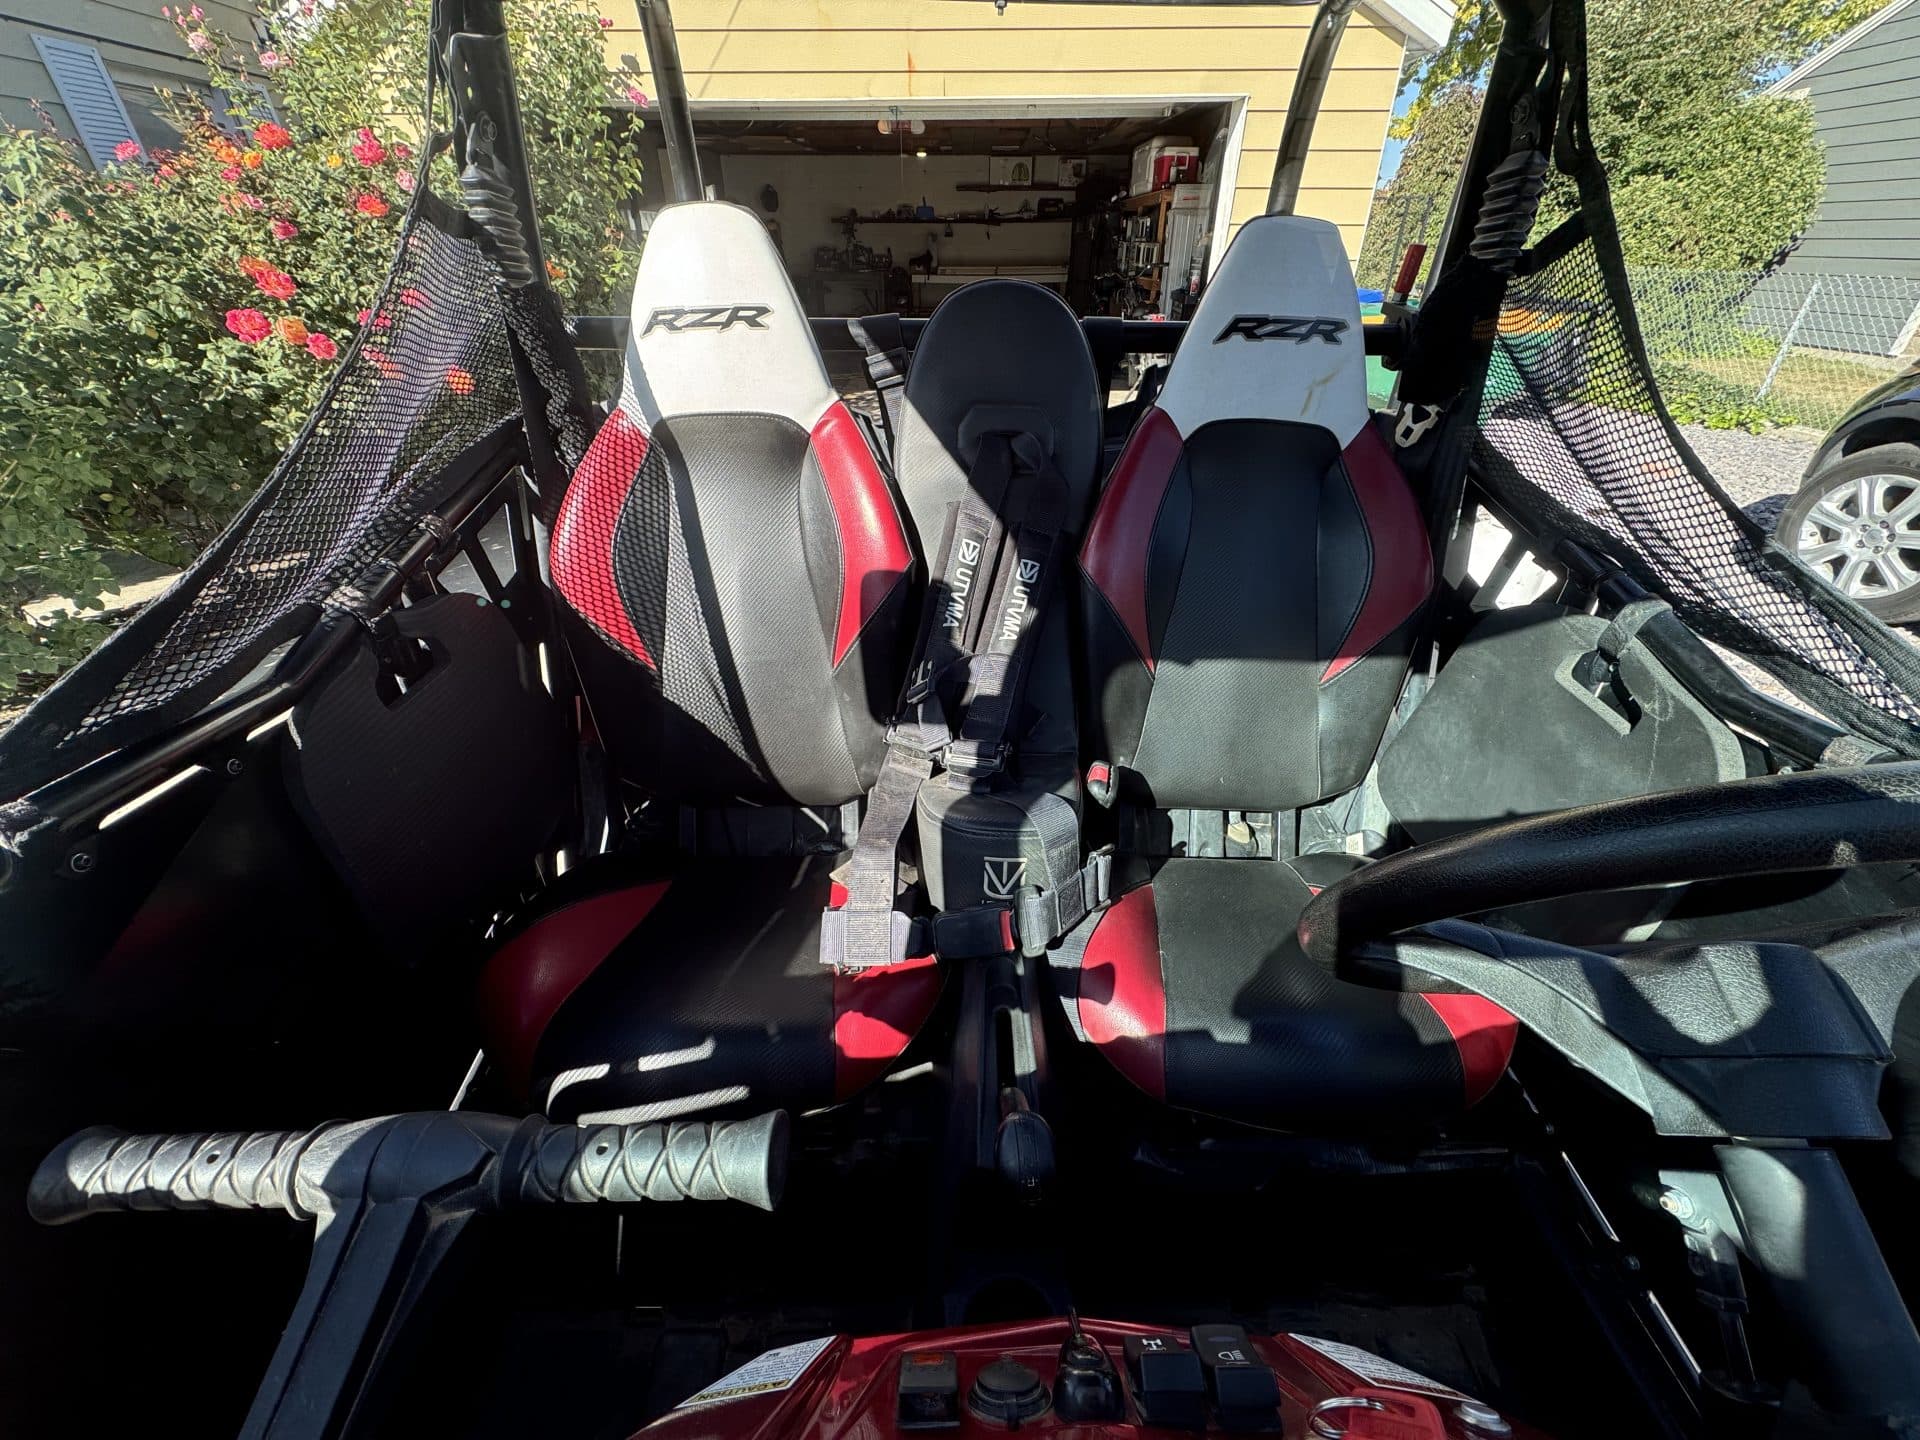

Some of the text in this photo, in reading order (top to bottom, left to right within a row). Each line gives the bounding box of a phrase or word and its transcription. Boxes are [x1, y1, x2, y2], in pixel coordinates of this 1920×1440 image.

[641, 305, 772, 338] RZR
[1213, 315, 1349, 343] RZR
[942, 567, 973, 628] UTVMA
[998, 585, 1031, 641] UTVMA
